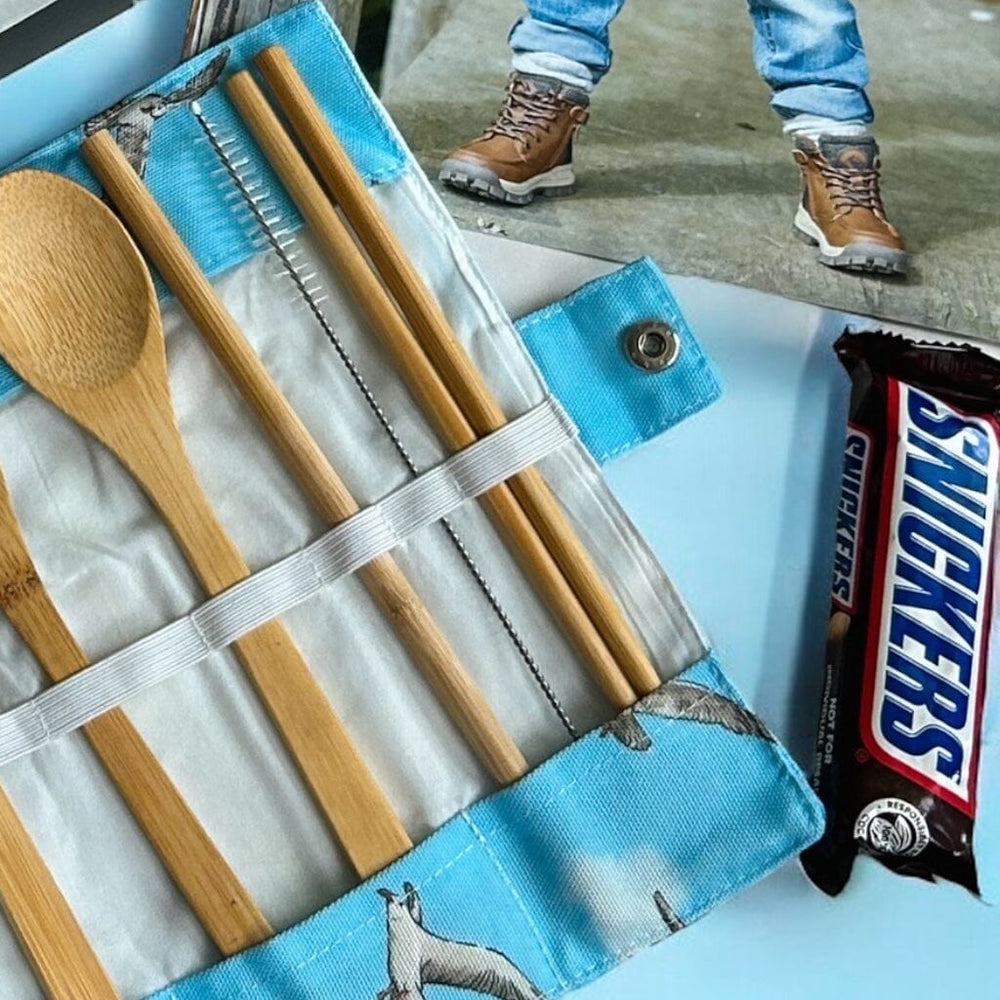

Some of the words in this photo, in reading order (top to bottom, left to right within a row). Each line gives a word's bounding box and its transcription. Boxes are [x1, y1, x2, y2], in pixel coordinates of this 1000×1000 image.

[832, 432, 867, 604] SNICKERS
[880, 387, 990, 785] SNICKERS
[824, 734, 835, 765] FOR
[826, 697, 837, 728] NOT
